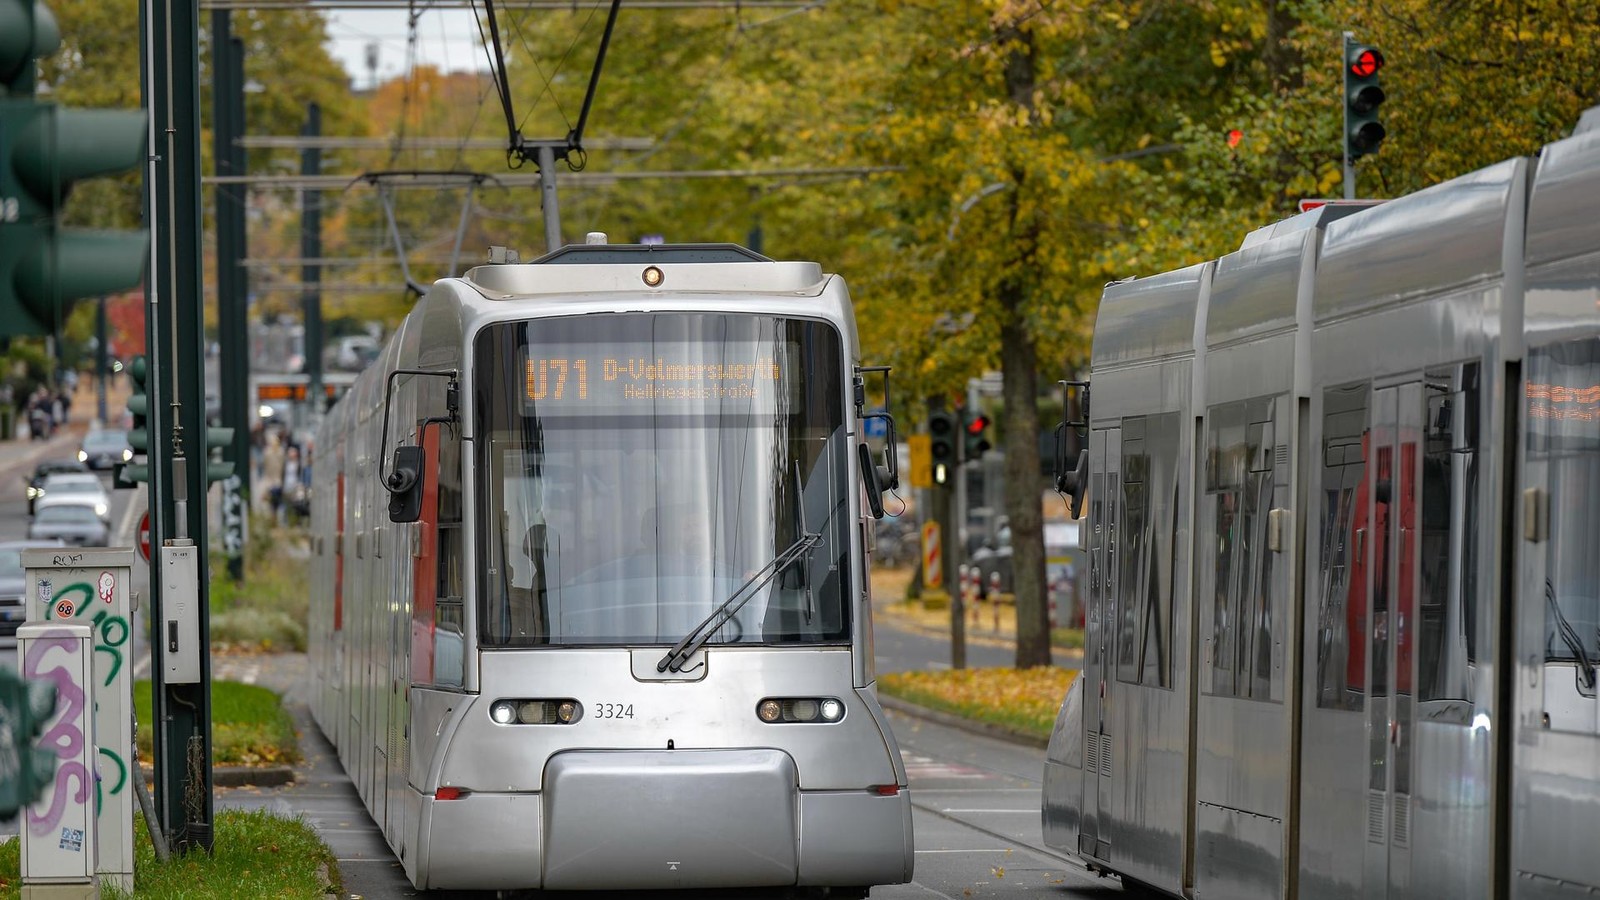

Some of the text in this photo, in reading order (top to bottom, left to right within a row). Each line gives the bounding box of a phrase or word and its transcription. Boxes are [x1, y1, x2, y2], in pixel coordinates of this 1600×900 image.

[527, 359, 587, 400] U71
[58, 603, 73, 615] 68
[594, 703, 634, 719] 3324
